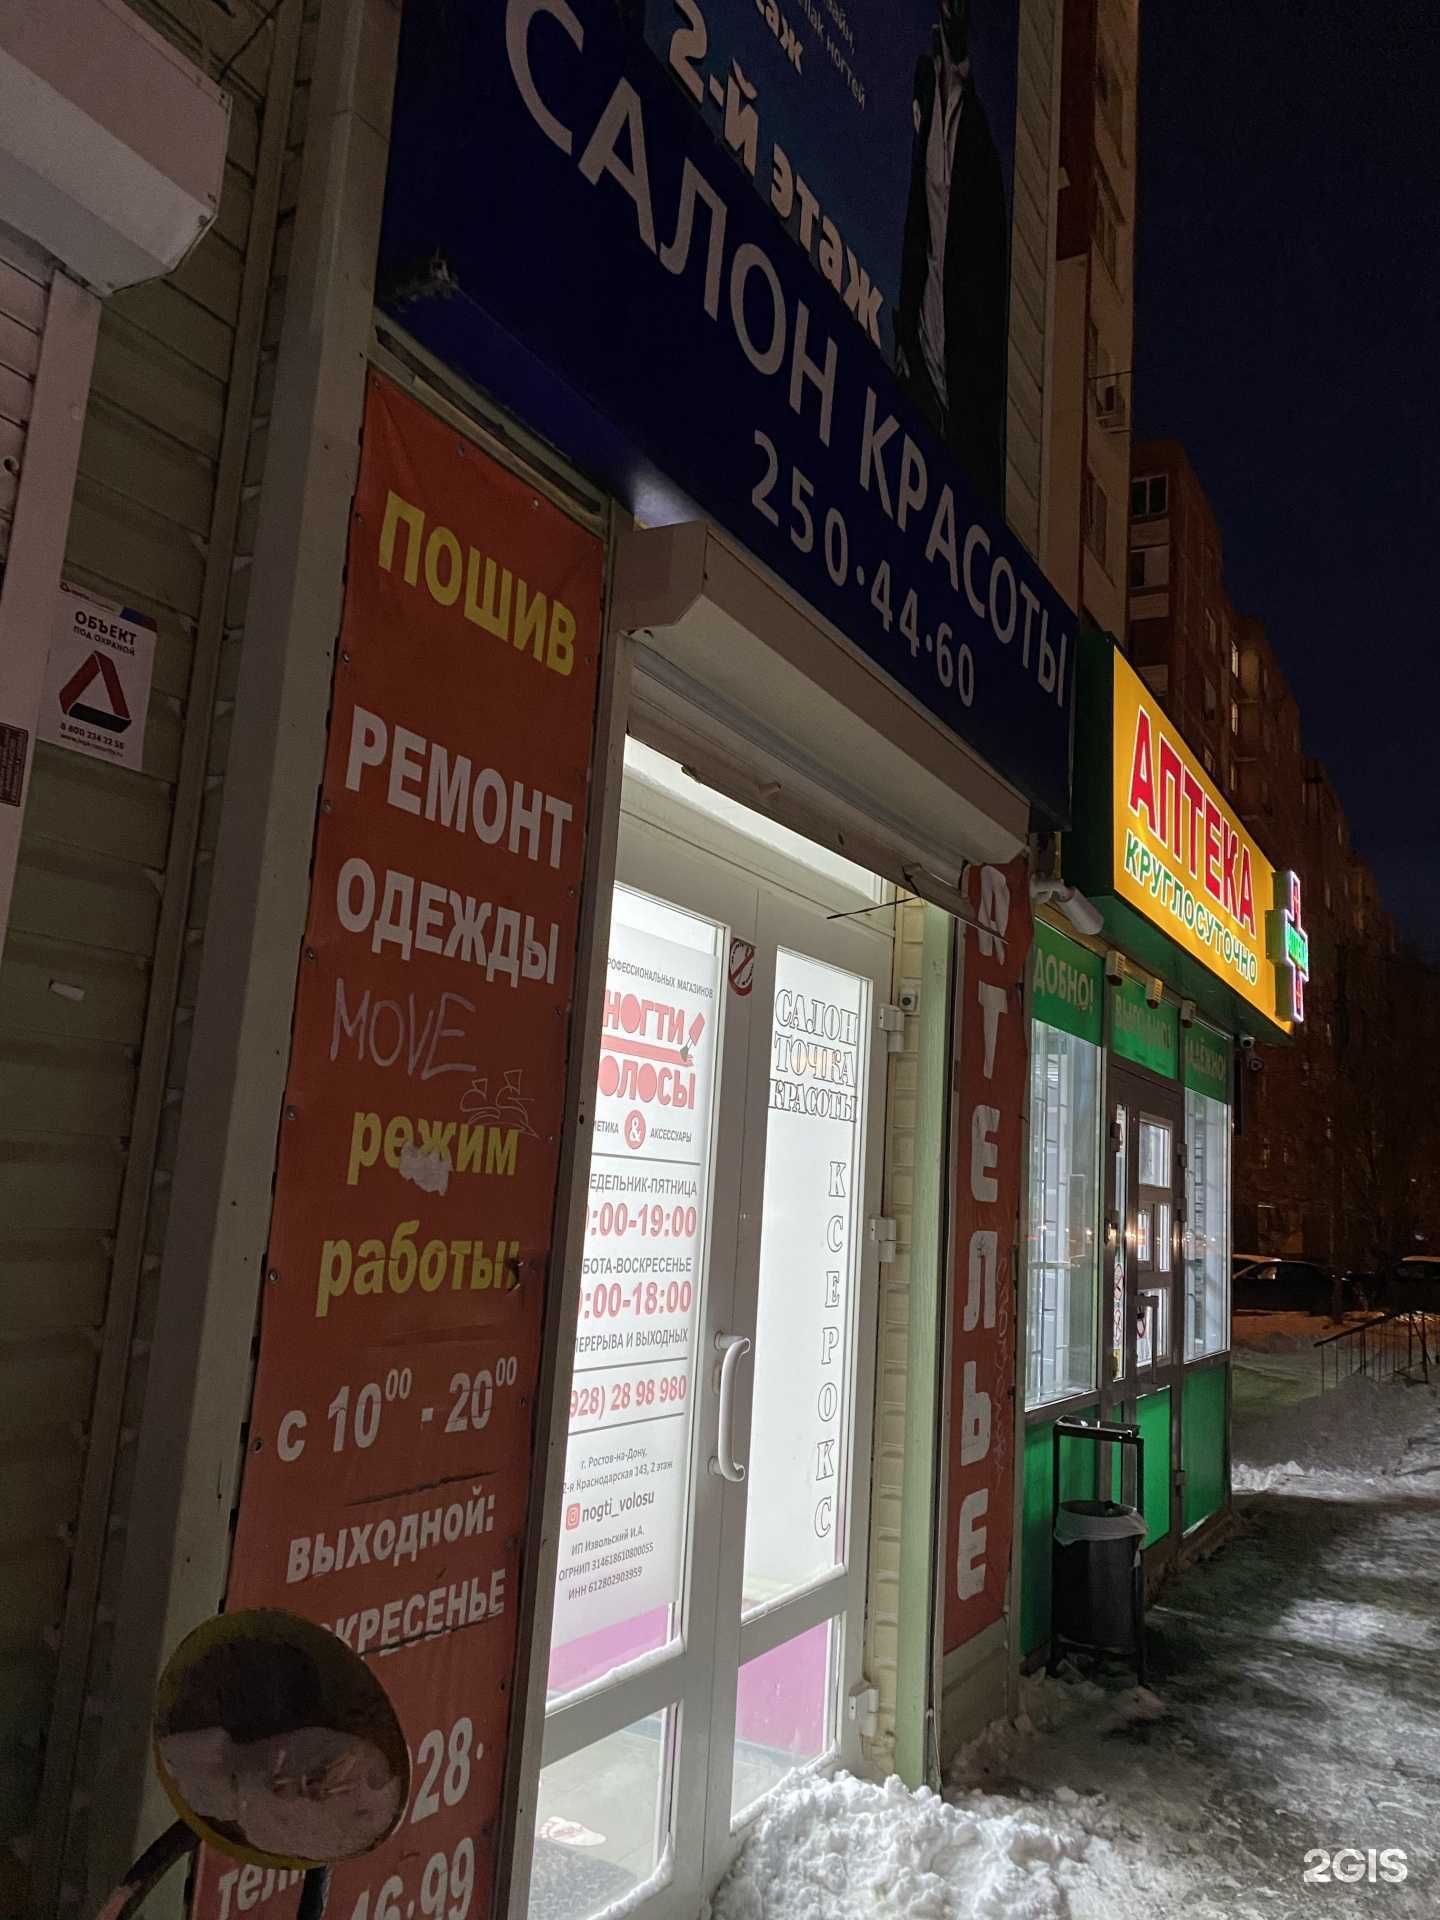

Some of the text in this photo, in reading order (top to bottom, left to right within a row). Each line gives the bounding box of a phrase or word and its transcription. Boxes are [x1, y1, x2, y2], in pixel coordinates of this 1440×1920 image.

[771, 143, 882, 349] этаж
[505, 0, 1067, 706] САЛОН КРАСОТЫ
[378, 490, 577, 676] ПОШИВ
[75, 611, 137, 646] ОБЪЕКТ
[345, 705, 572, 869] РЕМОНТ
[1128, 705, 1256, 940] АПТЕКА
[336, 857, 559, 988] ОДЕЖДЫ
[1124, 829, 1257, 986] КРУГЛОСУТОЧНО
[603, 989, 685, 1045] НОГТИ
[677, 980, 713, 998] МАГАЗИНОВ
[775, 989, 858, 1046] САЛОН
[330, 977, 477, 1081] MOVE
[774, 1031, 856, 1088] ТОЧКА
[768, 1079, 858, 1123] КРАСОТЫ
[347, 1112, 521, 1185] режим
[593, 1119, 619, 1134] ЕТИКА
[650, 1127, 691, 1143] АКСЕССУАРЫ
[586, 1202, 697, 1238] :00-19:00
[957, 866, 1008, 1601] АТЕЛЬЕ
[579, 1280, 692, 1319] :00-18:00
[626, 1331, 634, 1348] И
[636, 1327, 688, 1346] ВЫХОДНЫХ
[814, 1161, 847, 1539] КСЕРОКС
[611, 1382, 631, 1410] 28
[636, 1379, 655, 1407] 98
[660, 1375, 688, 1402] 980
[576, 1469, 634, 1491] Краснодарская
[582, 1490, 655, 1522] nogti_volosu
[286, 1485, 496, 1584] ВЫХОДНОЙ:
[571, 1541, 584, 1557] ИП
[585, 1529, 630, 1552] Извольский
[559, 1561, 590, 1581] ОГРНИП
[568, 1583, 587, 1600] ИНН
[319, 1569, 506, 1658] КРЕСЕНЬЕ
